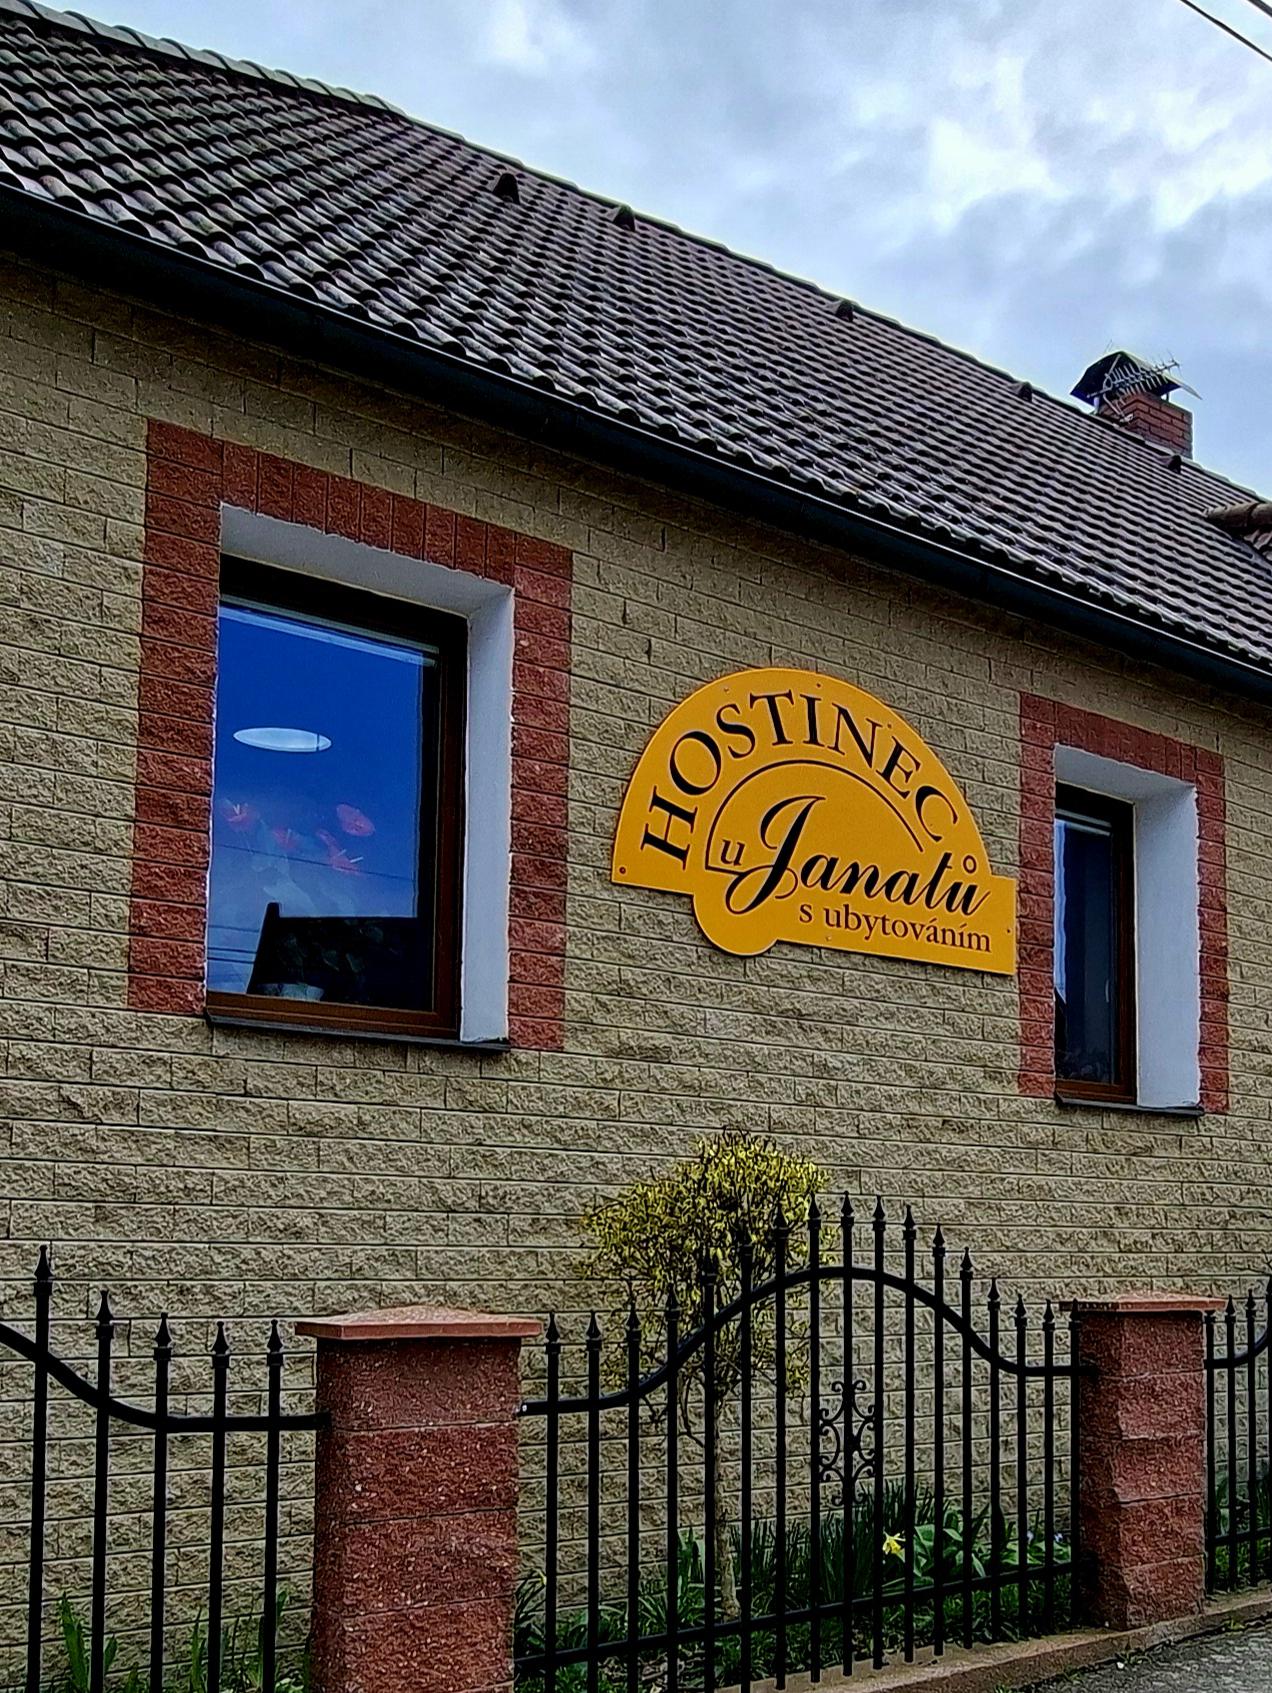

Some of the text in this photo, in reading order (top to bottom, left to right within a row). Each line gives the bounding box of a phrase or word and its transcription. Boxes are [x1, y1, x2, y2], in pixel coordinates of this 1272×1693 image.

[640, 692, 959, 871] HOSTINEC
[721, 796, 991, 916] u Janatů
[799, 905, 991, 953] s ubytováním
